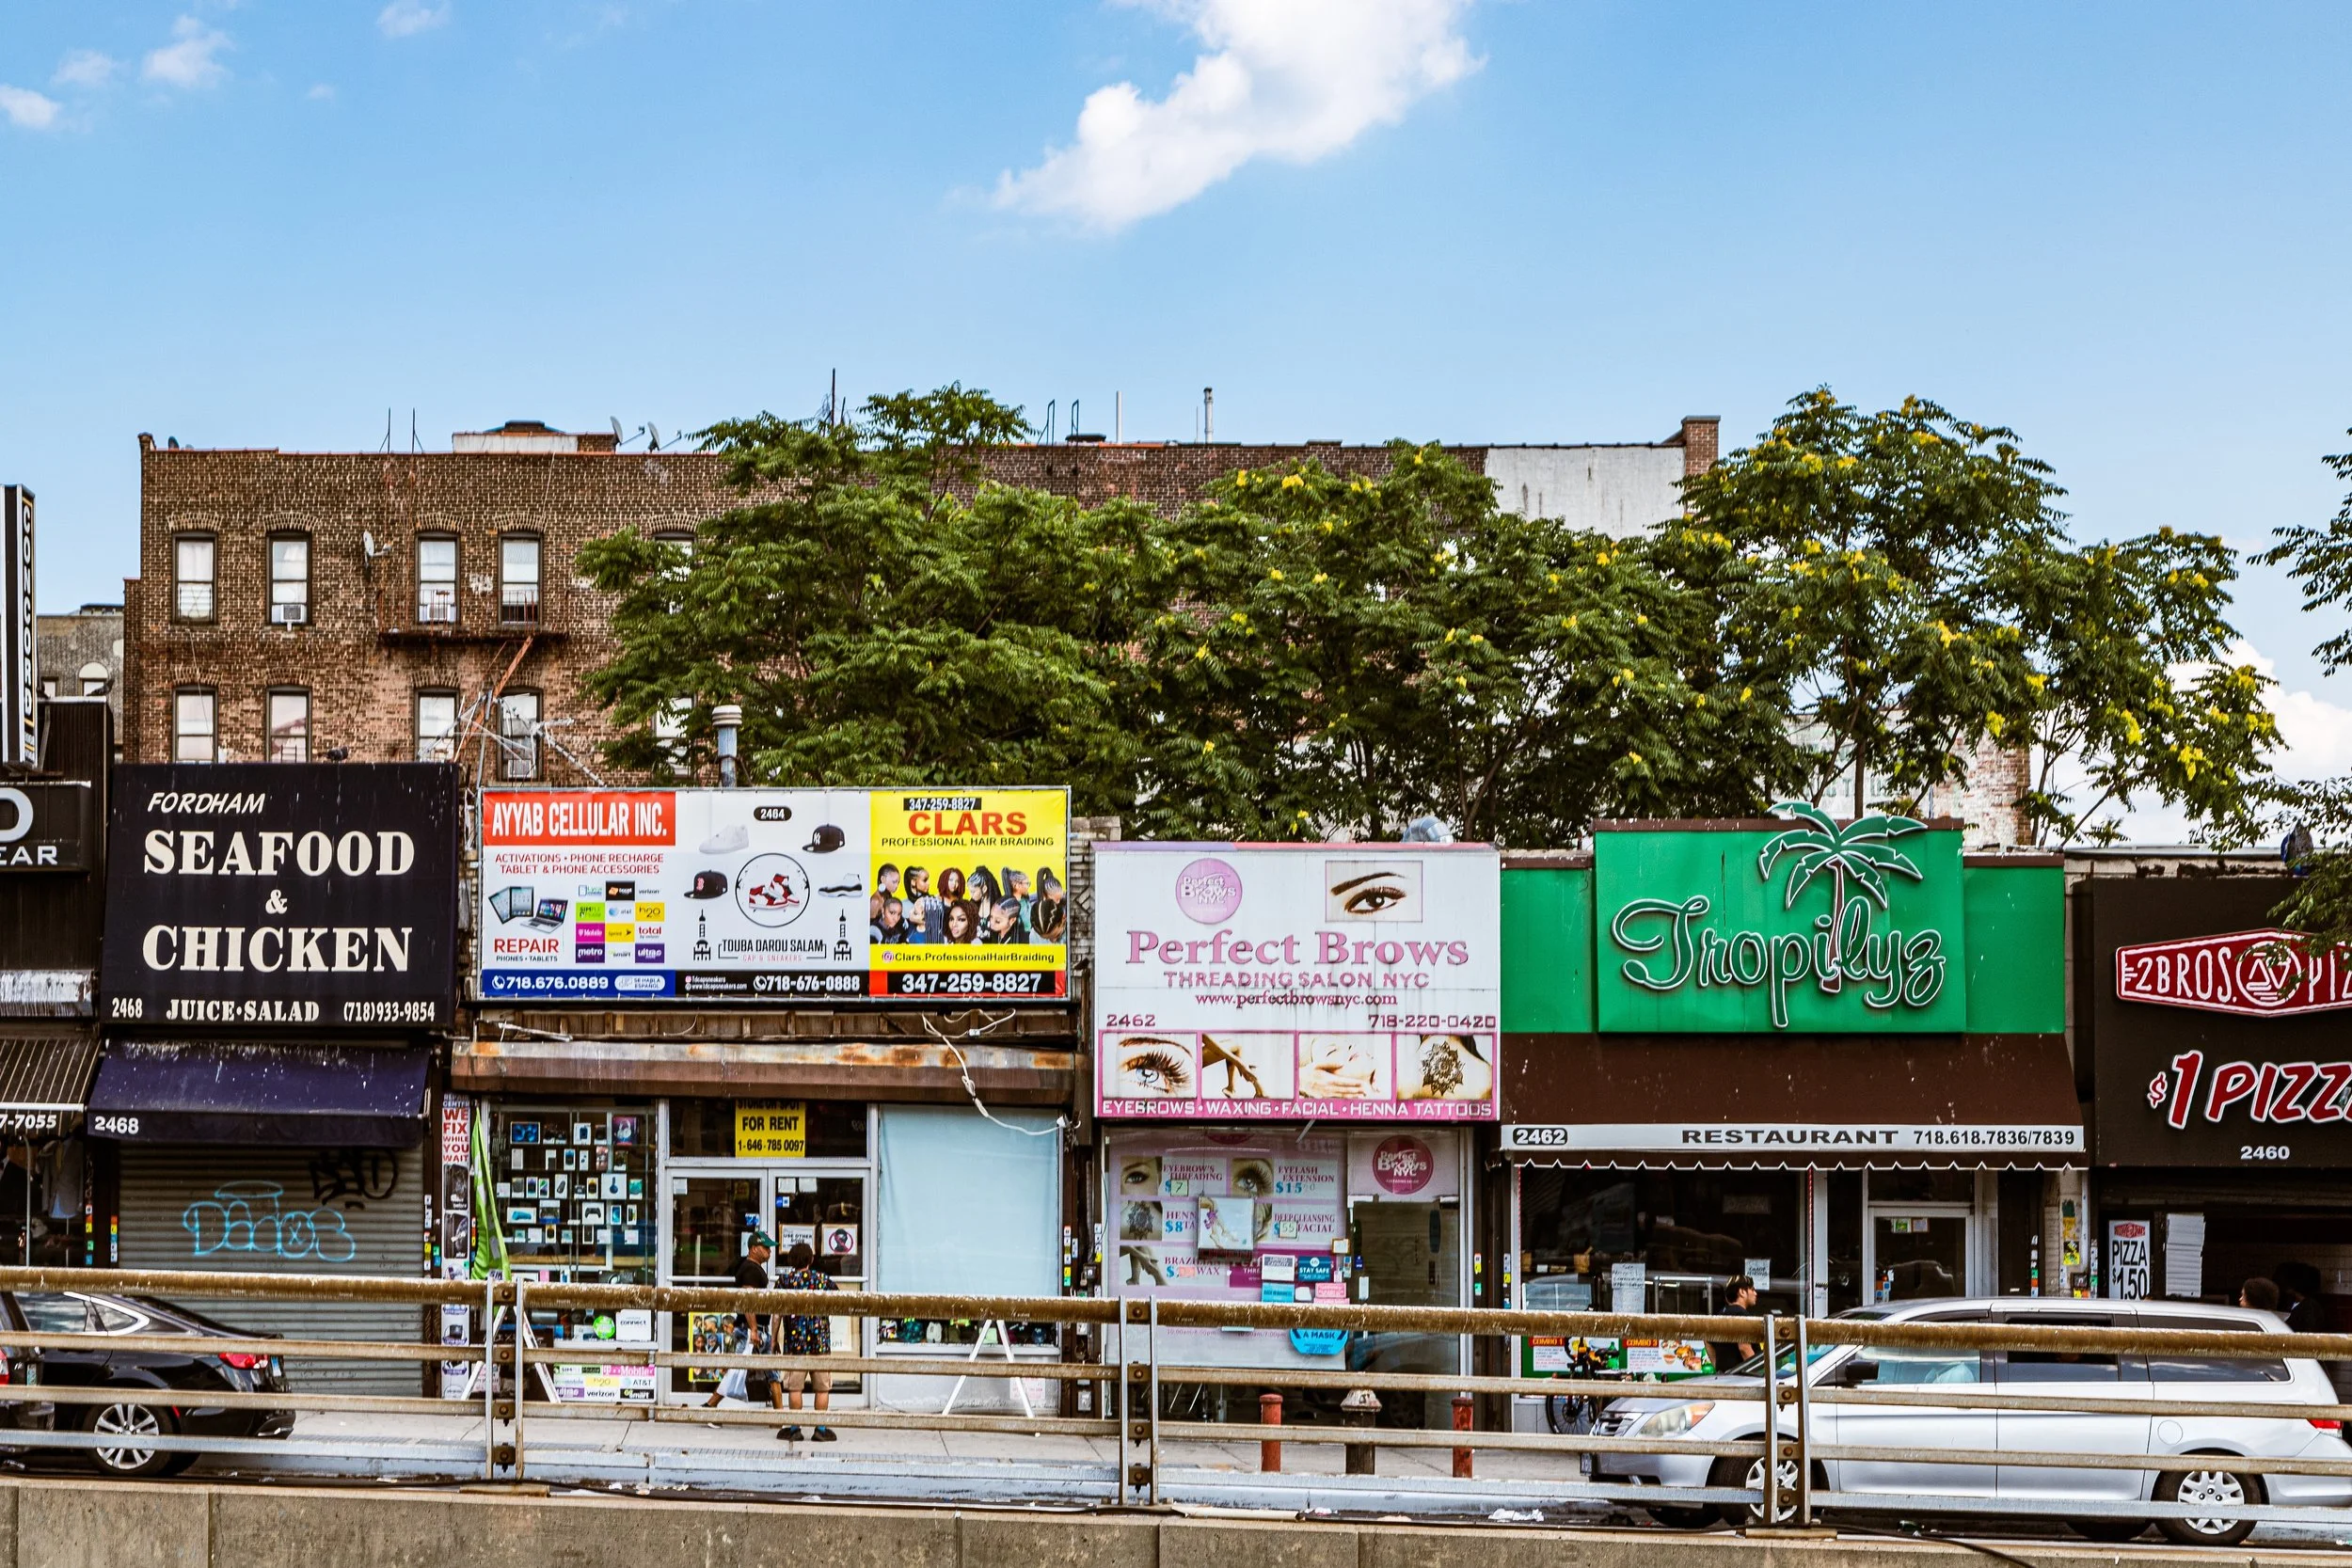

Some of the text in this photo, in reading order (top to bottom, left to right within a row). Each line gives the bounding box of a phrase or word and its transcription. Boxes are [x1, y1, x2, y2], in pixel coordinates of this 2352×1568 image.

[23, 502, 33, 718] CONCORD
[148, 792, 265, 815] FORDHAM
[909, 798, 976, 810] 347-259-8827
[492, 802, 667, 836] AYYAB CELLULAR INC.
[909, 812, 1026, 835] CLARS
[882, 837, 1054, 847] PROFESSIONAL HAIR BRAIDING
[144, 830, 415, 877] SEAFOOD
[495, 853, 664, 863] ACTIVATIONS PHONE RECHARGE
[501, 864, 660, 875] TABLET & PHONE ACCESSORIES
[265, 890, 288, 914] &
[638, 926, 662, 935] total
[142, 925, 413, 973] CHICKEN
[493, 938, 560, 954] REPAIR
[722, 940, 823, 952] TOUBA DAROU SALAM
[1126, 929, 1469, 965] Perfect Brows
[895, 952, 1055, 962] Clars.ProfessionalHairBraiding
[1611, 895, 1947, 1028] Tropilyz
[506, 976, 609, 990] 718.676.0889
[766, 975, 861, 991] 718-676-0888
[902, 974, 1041, 993] 347-259-8827
[1164, 972, 1430, 988] THREADING SALON NYC
[1196, 990, 1398, 1009] www.perfectbrowsnyc.com
[112, 997, 143, 1019] 2468
[343, 1001, 436, 1022] (718)933-9854
[1106, 1014, 1497, 1028] 2462 718-220-0420
[2204, 1061, 2352, 1124] PIZZ
[444, 1109, 469, 1120] WE
[1103, 1101, 1492, 1117] EYEBROWS WAXING FACIAL HENNA TATTOOS
[94, 1116, 140, 1134] 2468
[443, 1122, 468, 1134] FIX
[742, 1117, 799, 1131] FOR RENT
[784, 1139, 804, 1151] 0097
[1515, 1130, 2075, 1146] 2462 RESTAURANT 718.618.7836/7839
[443, 1145, 469, 1153] YOU
[2241, 1146, 2290, 1160] 2460
[1297, 1224, 1335, 1232] FACIAL
[2112, 1240, 2147, 1266] PIZZA
[1197, 1266, 1220, 1275] WAX
[2112, 1267, 2148, 1300] $1.50
